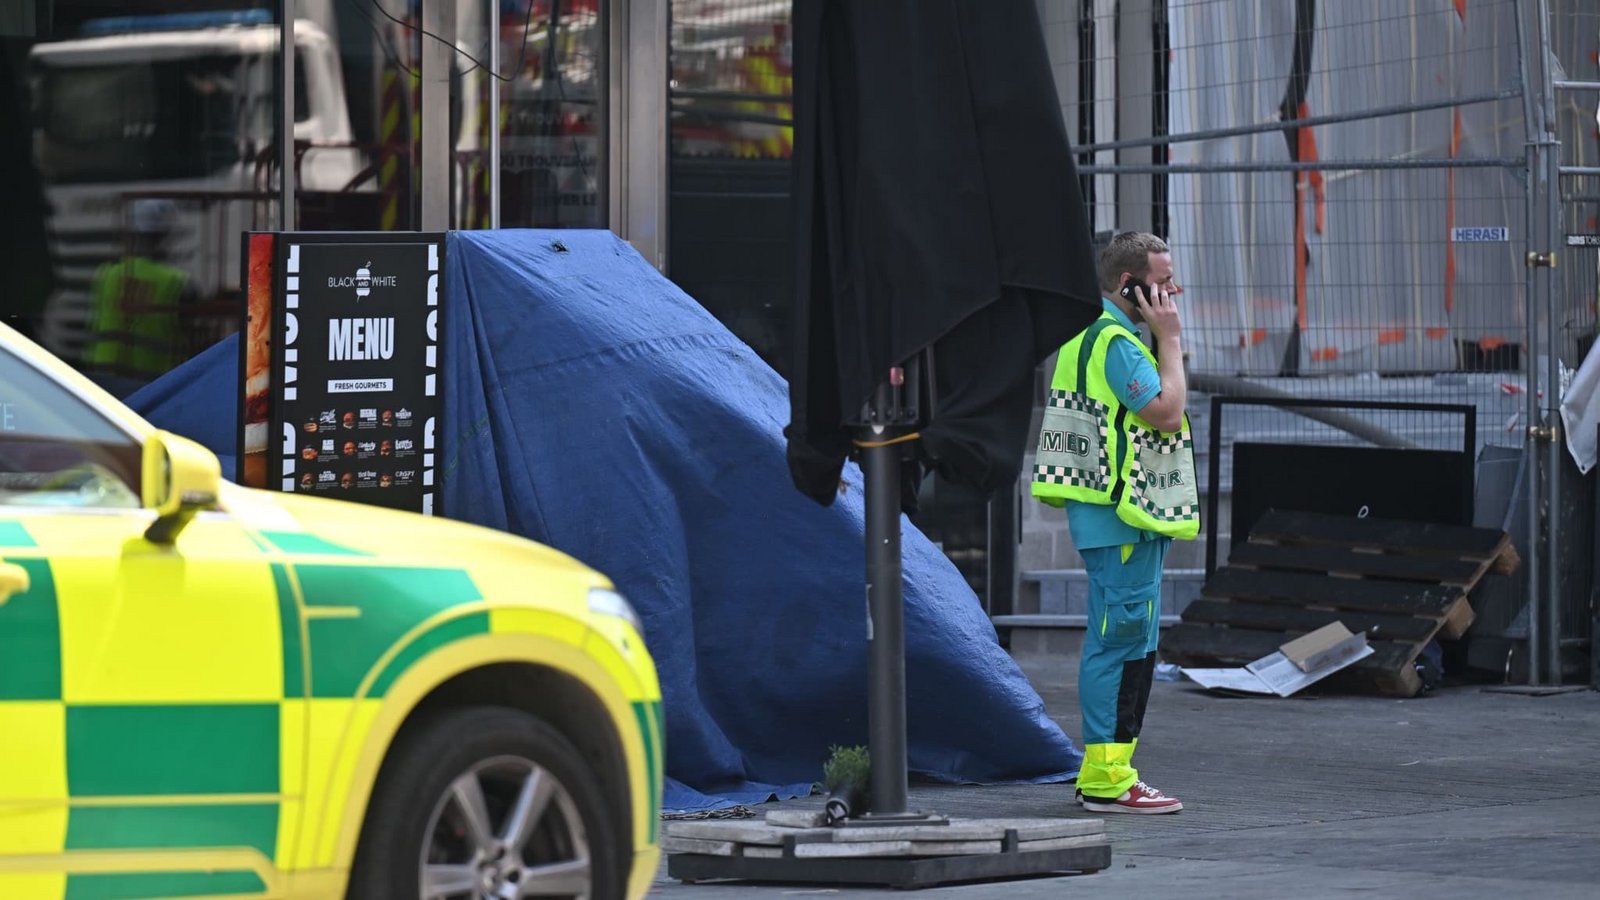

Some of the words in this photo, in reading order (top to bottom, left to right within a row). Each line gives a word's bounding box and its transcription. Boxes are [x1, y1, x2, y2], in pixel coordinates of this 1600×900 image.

[1456, 228, 1499, 240] HERAS
[328, 276, 354, 288] BLACK
[371, 275, 396, 287] WHITE
[328, 317, 395, 361] MENU
[334, 382, 354, 390] FRESH
[355, 381, 387, 390] GOURMETS
[1042, 430, 1092, 457] MED
[1146, 468, 1184, 491] DIR
